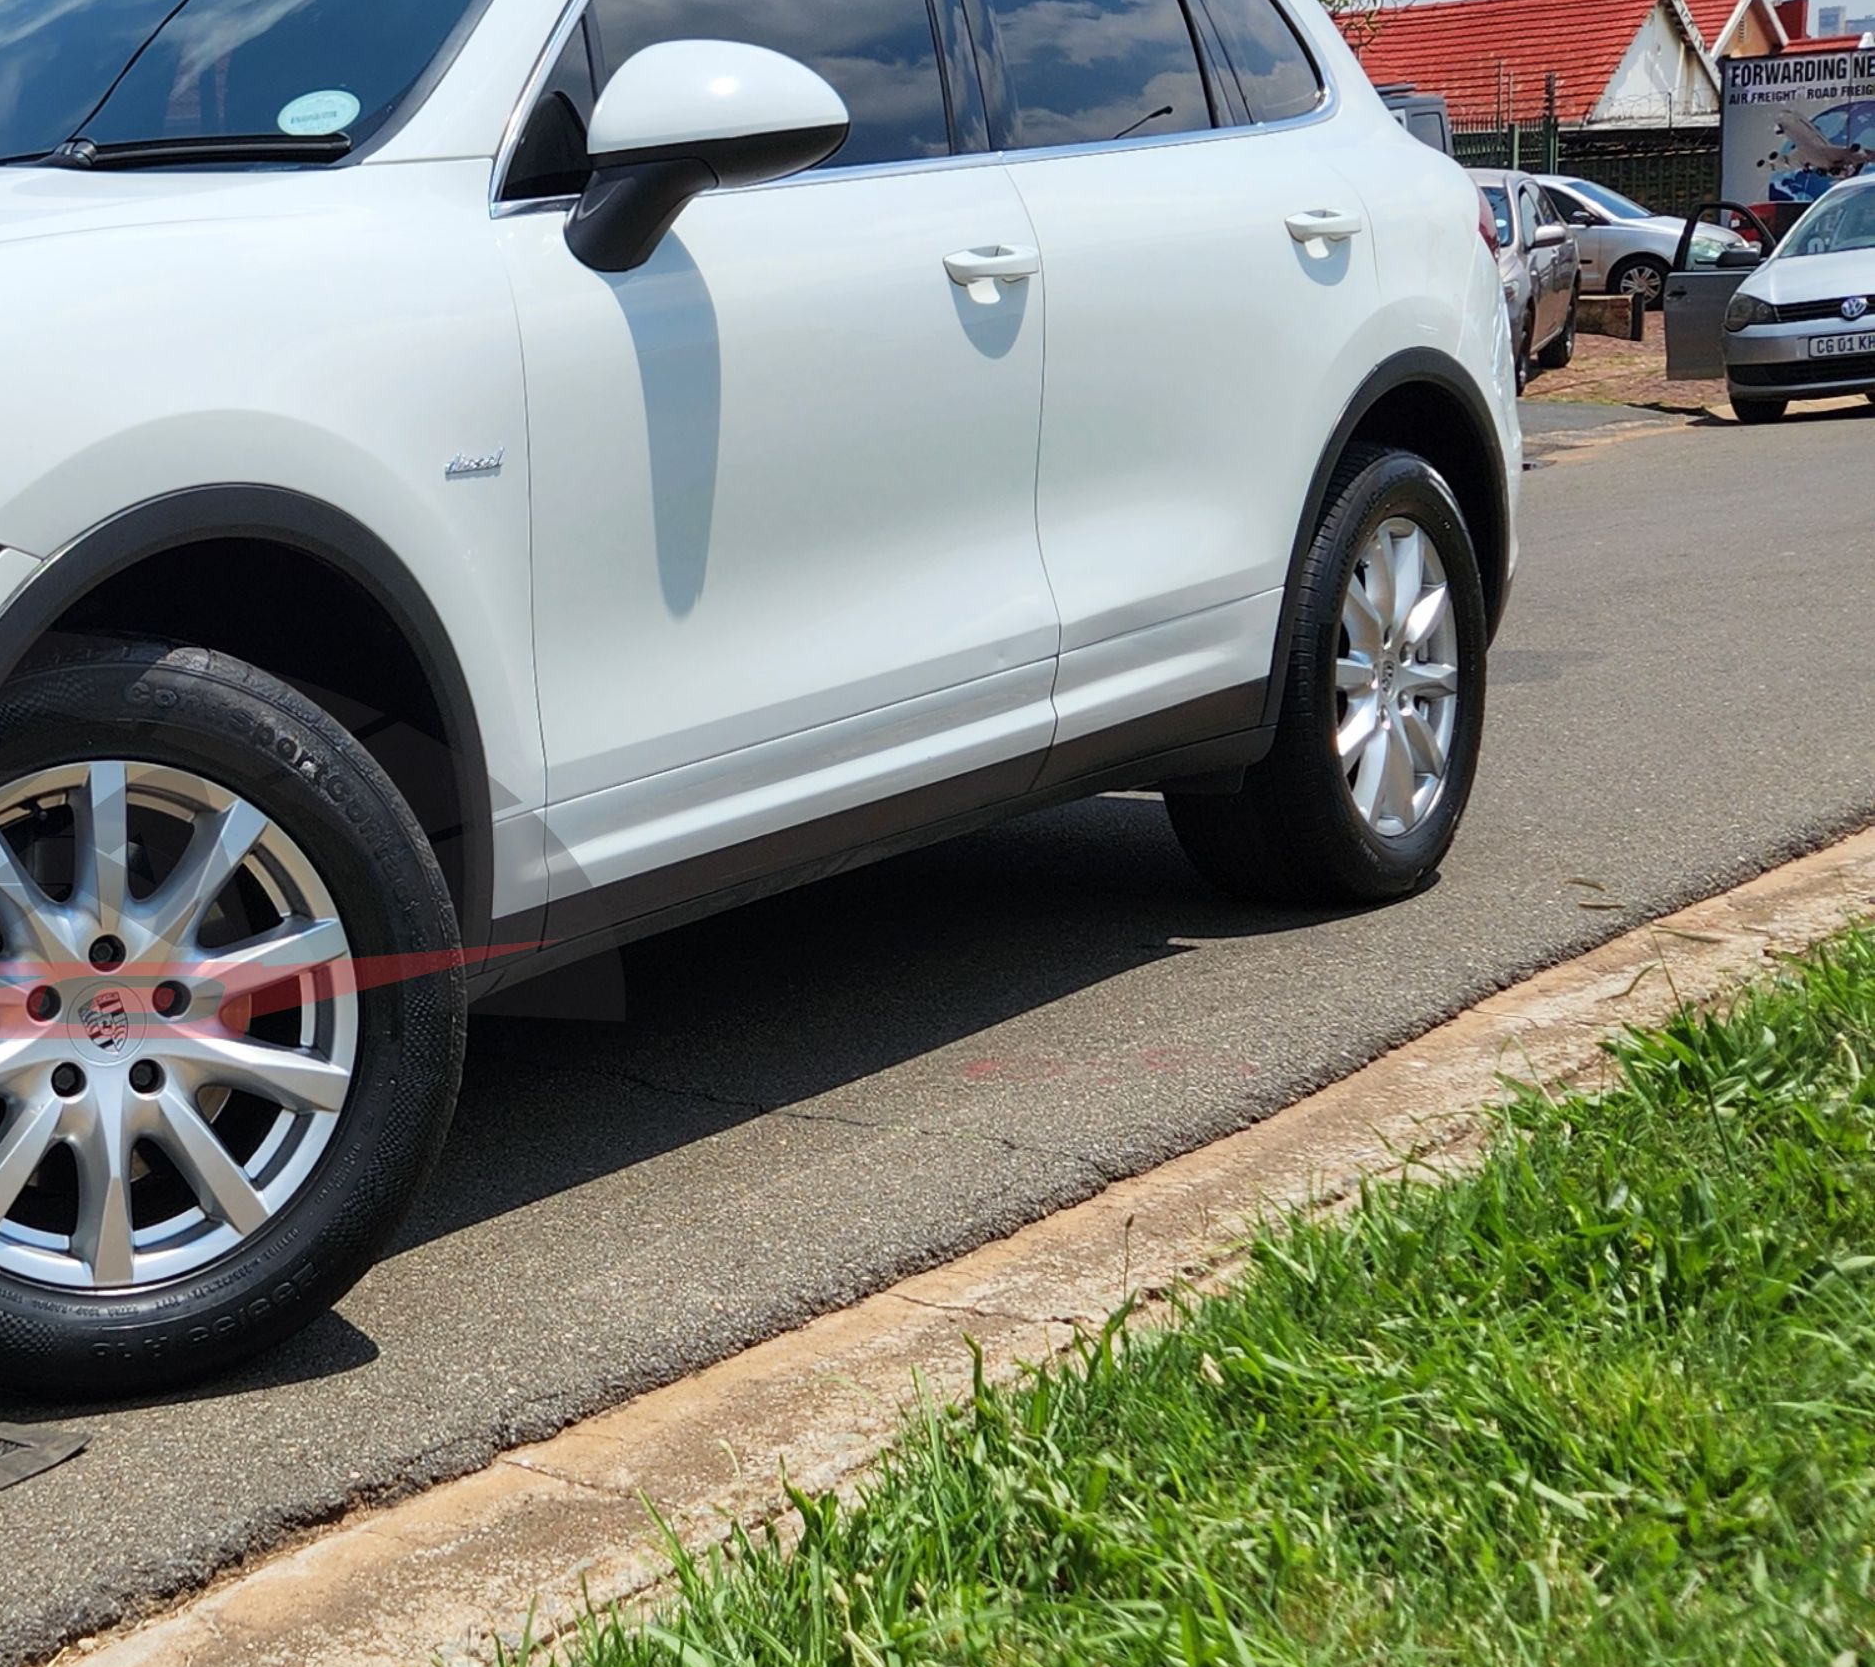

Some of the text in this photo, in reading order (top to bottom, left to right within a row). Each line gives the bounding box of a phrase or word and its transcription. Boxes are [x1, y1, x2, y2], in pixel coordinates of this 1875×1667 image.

[1731, 57, 1847, 88] FORWARDING
[1729, 92, 1748, 105] AIR
[1749, 89, 1797, 103] FREIGHT
[1807, 86, 1837, 100] ROAD
[1816, 339, 1834, 354] CG
[1838, 337, 1855, 352] 01
